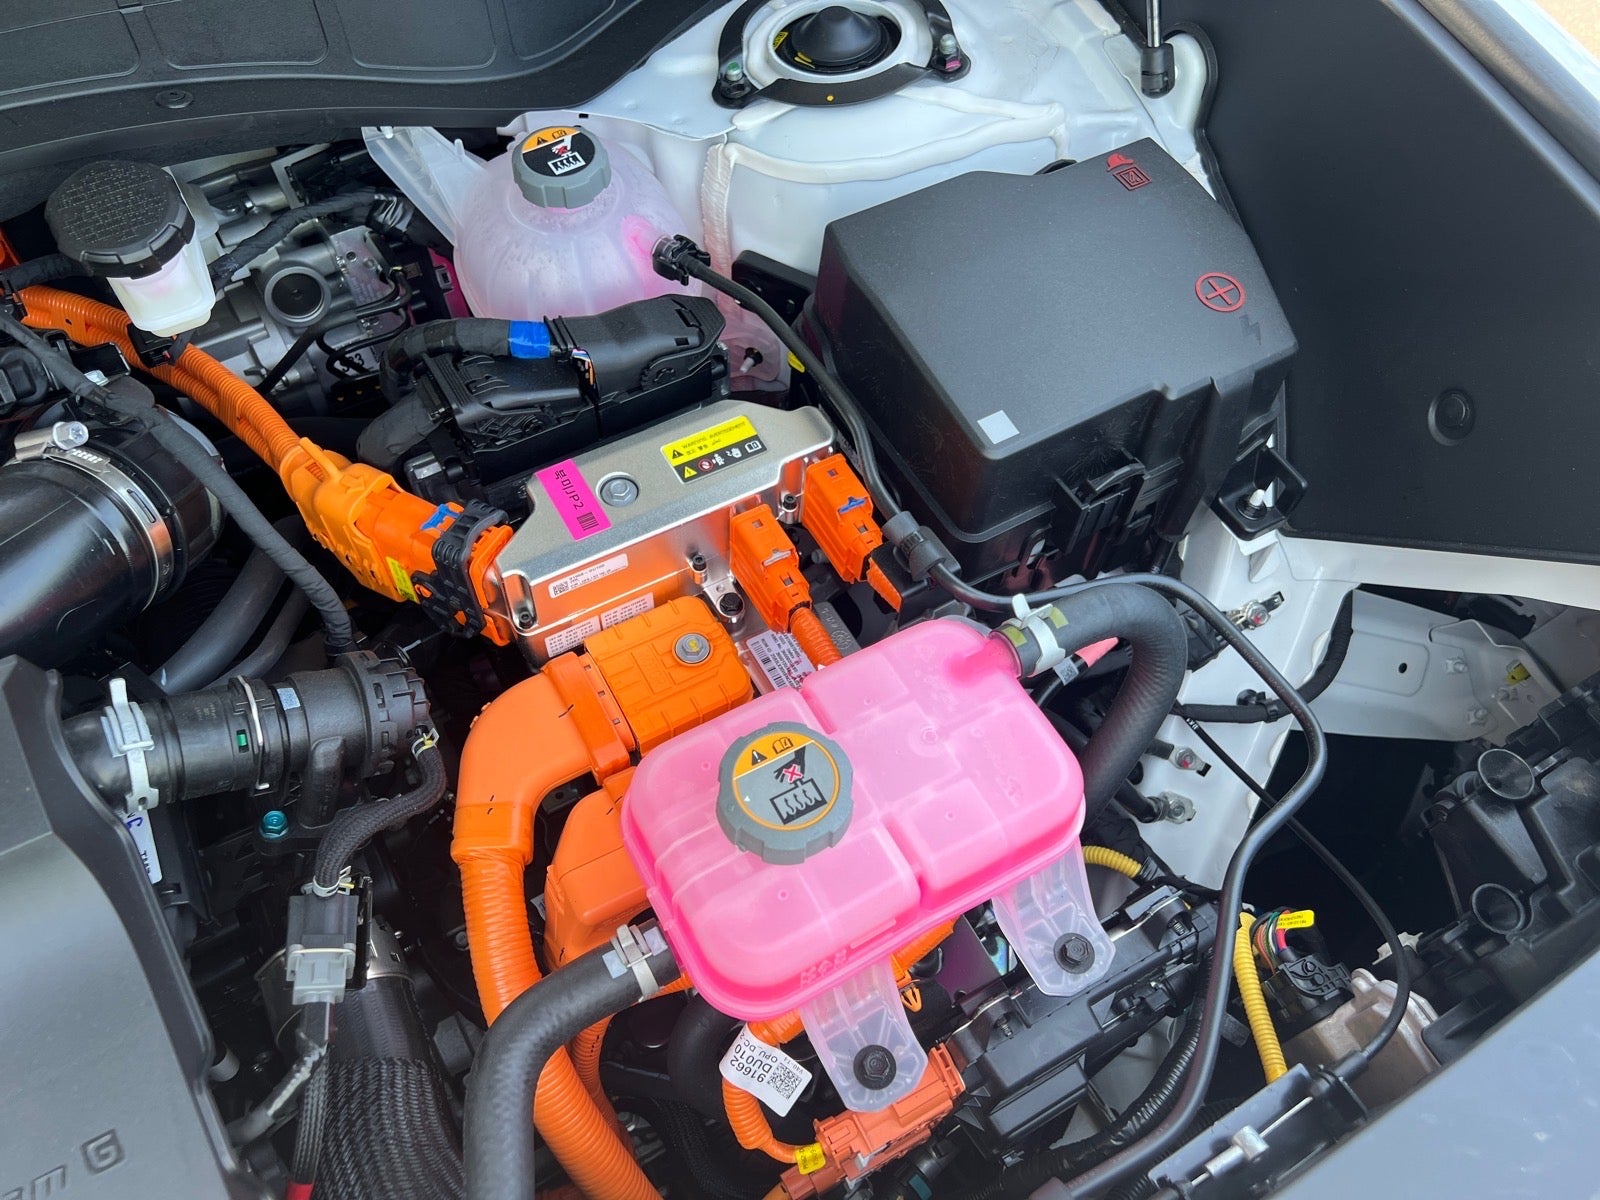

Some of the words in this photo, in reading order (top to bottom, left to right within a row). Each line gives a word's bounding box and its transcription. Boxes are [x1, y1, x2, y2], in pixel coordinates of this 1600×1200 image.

[553, 468, 584, 510] 북미JP2
[730, 1055, 766, 1082] 91662
[735, 1044, 773, 1073] DU010
[80, 1128, 125, 1174] G
